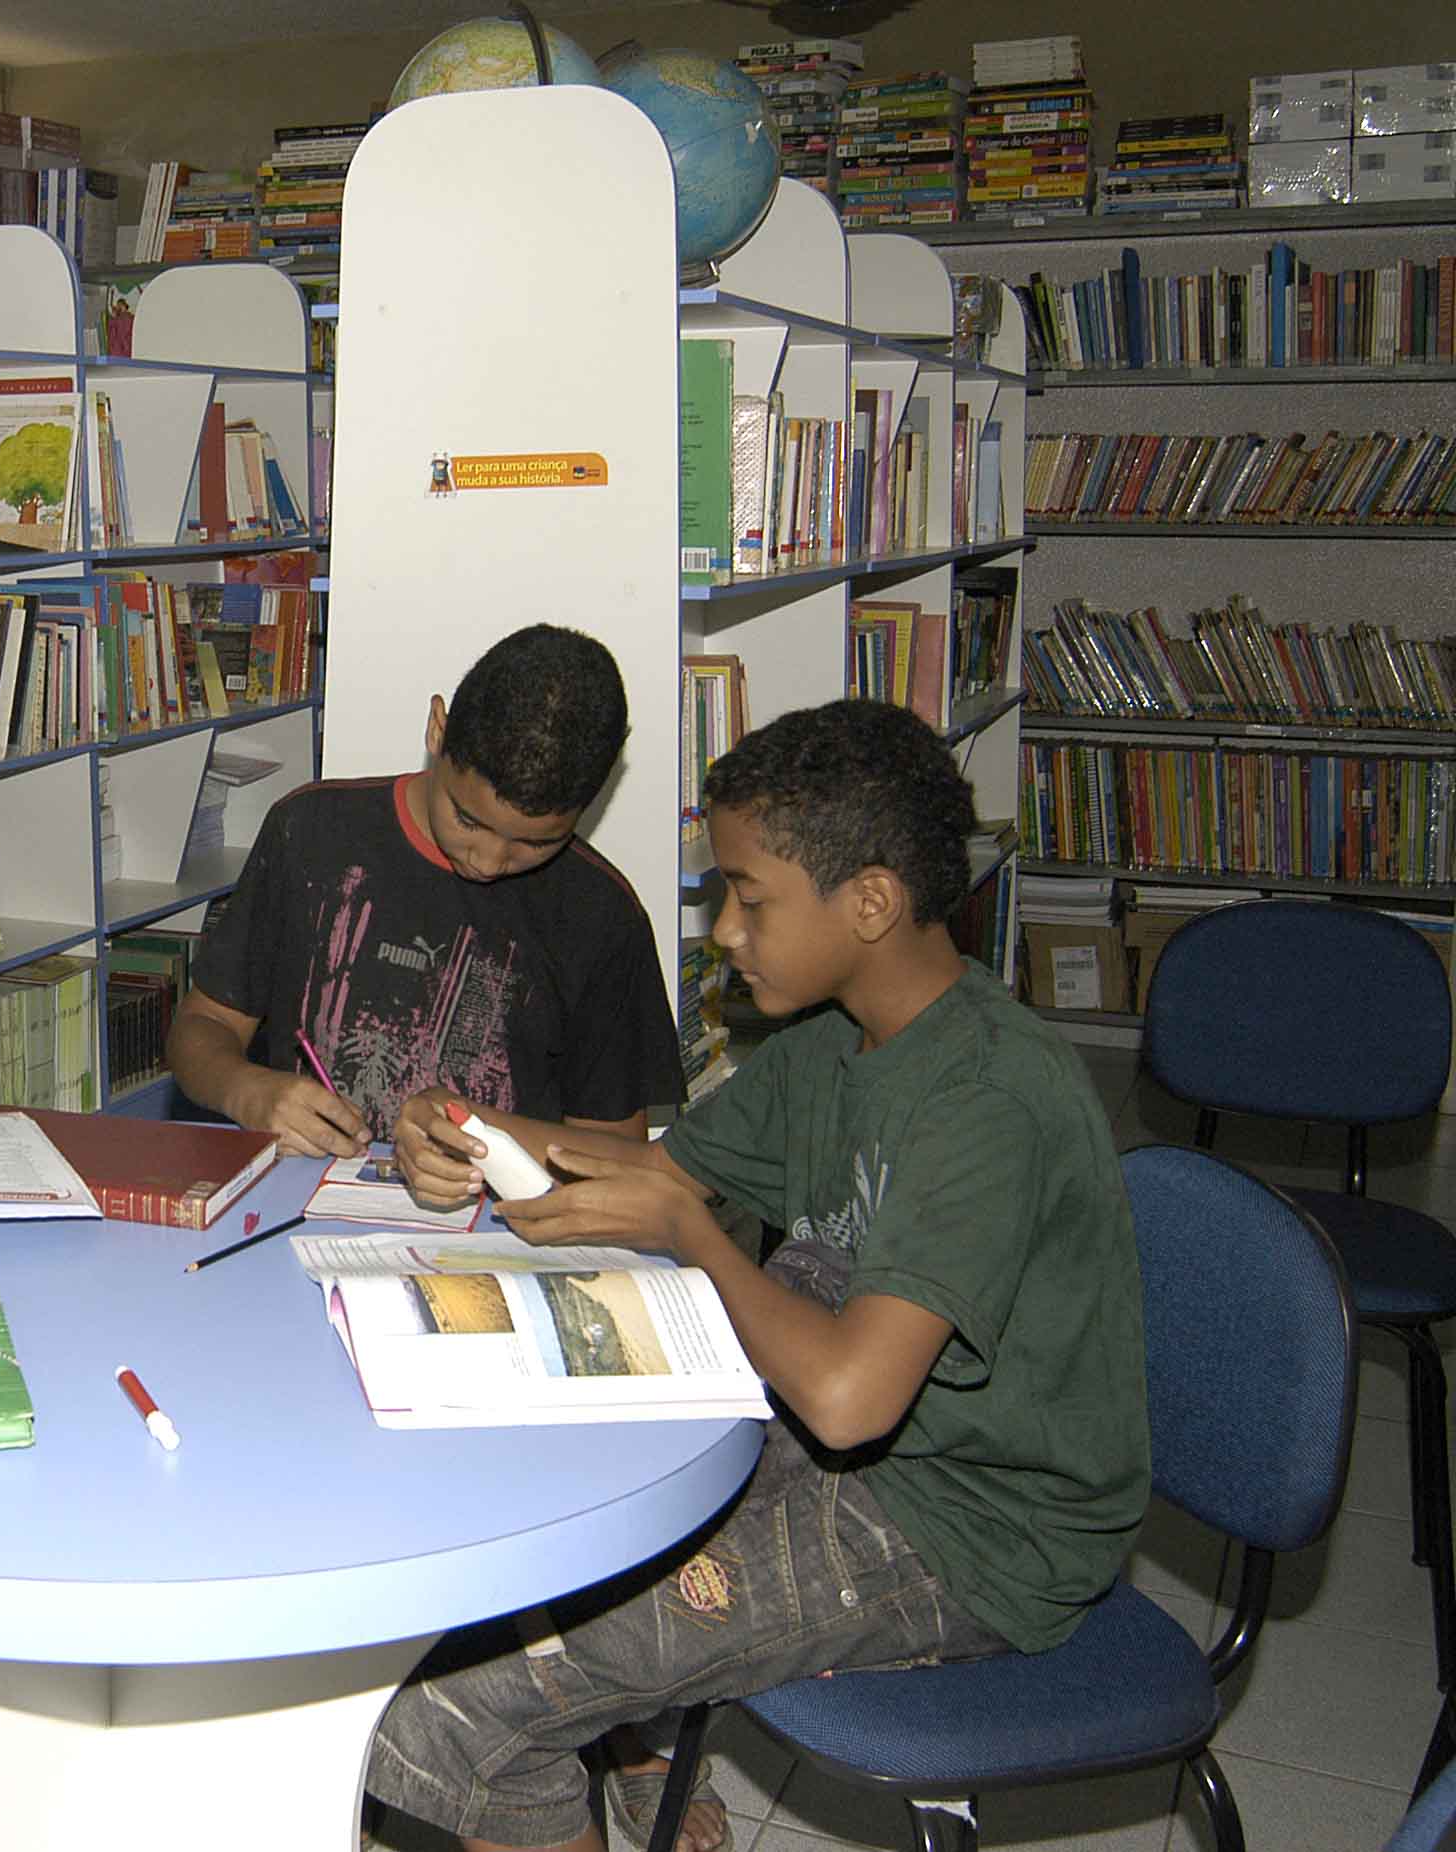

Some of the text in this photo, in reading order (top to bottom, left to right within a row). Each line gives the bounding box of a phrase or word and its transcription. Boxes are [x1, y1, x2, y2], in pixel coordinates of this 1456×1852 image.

[456, 462, 474, 473] Ler
[475, 463, 500, 474] para
[501, 463, 526, 472] uma
[528, 461, 568, 472] criança
[456, 475, 488, 486] muda
[498, 476, 517, 486] sua
[377, 942, 426, 971] PUMA
